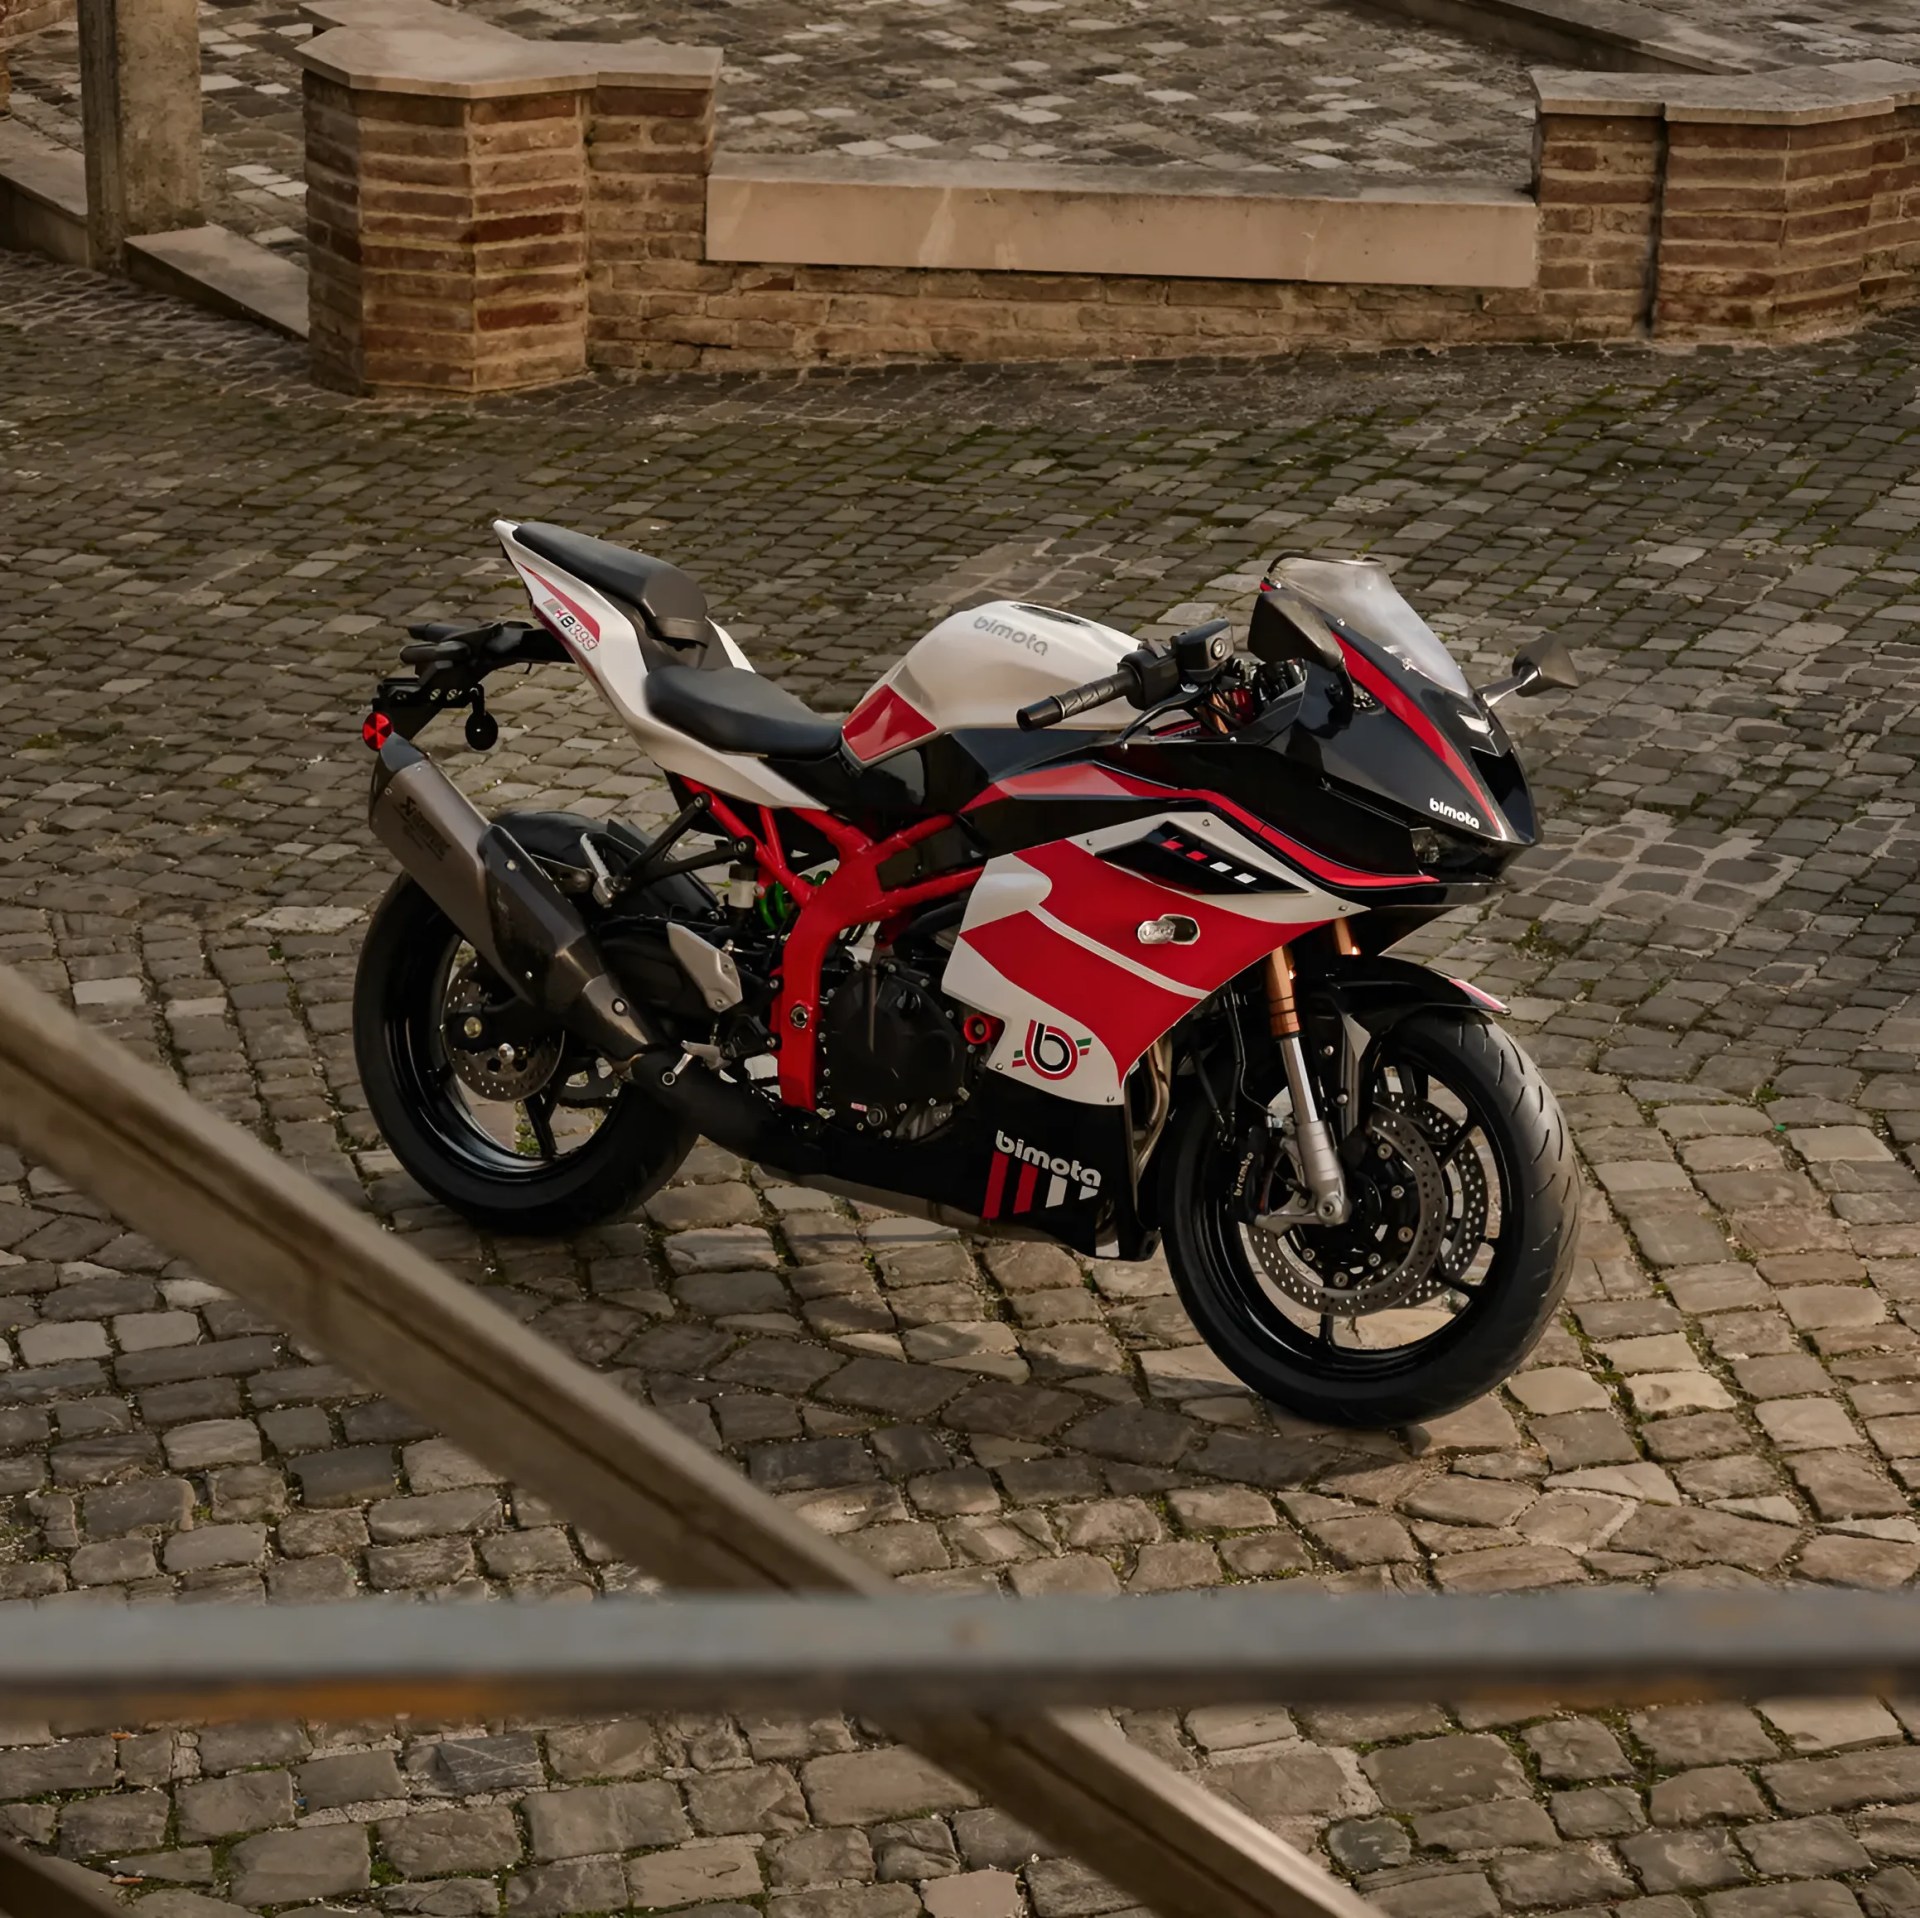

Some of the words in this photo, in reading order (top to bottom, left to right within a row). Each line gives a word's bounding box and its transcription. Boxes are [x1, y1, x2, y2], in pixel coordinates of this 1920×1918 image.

[974, 616, 1048, 656] bimota
[1429, 798, 1479, 829] bimota
[995, 1129, 1101, 1187] bimota
[1233, 1152, 1254, 1196] brembo
